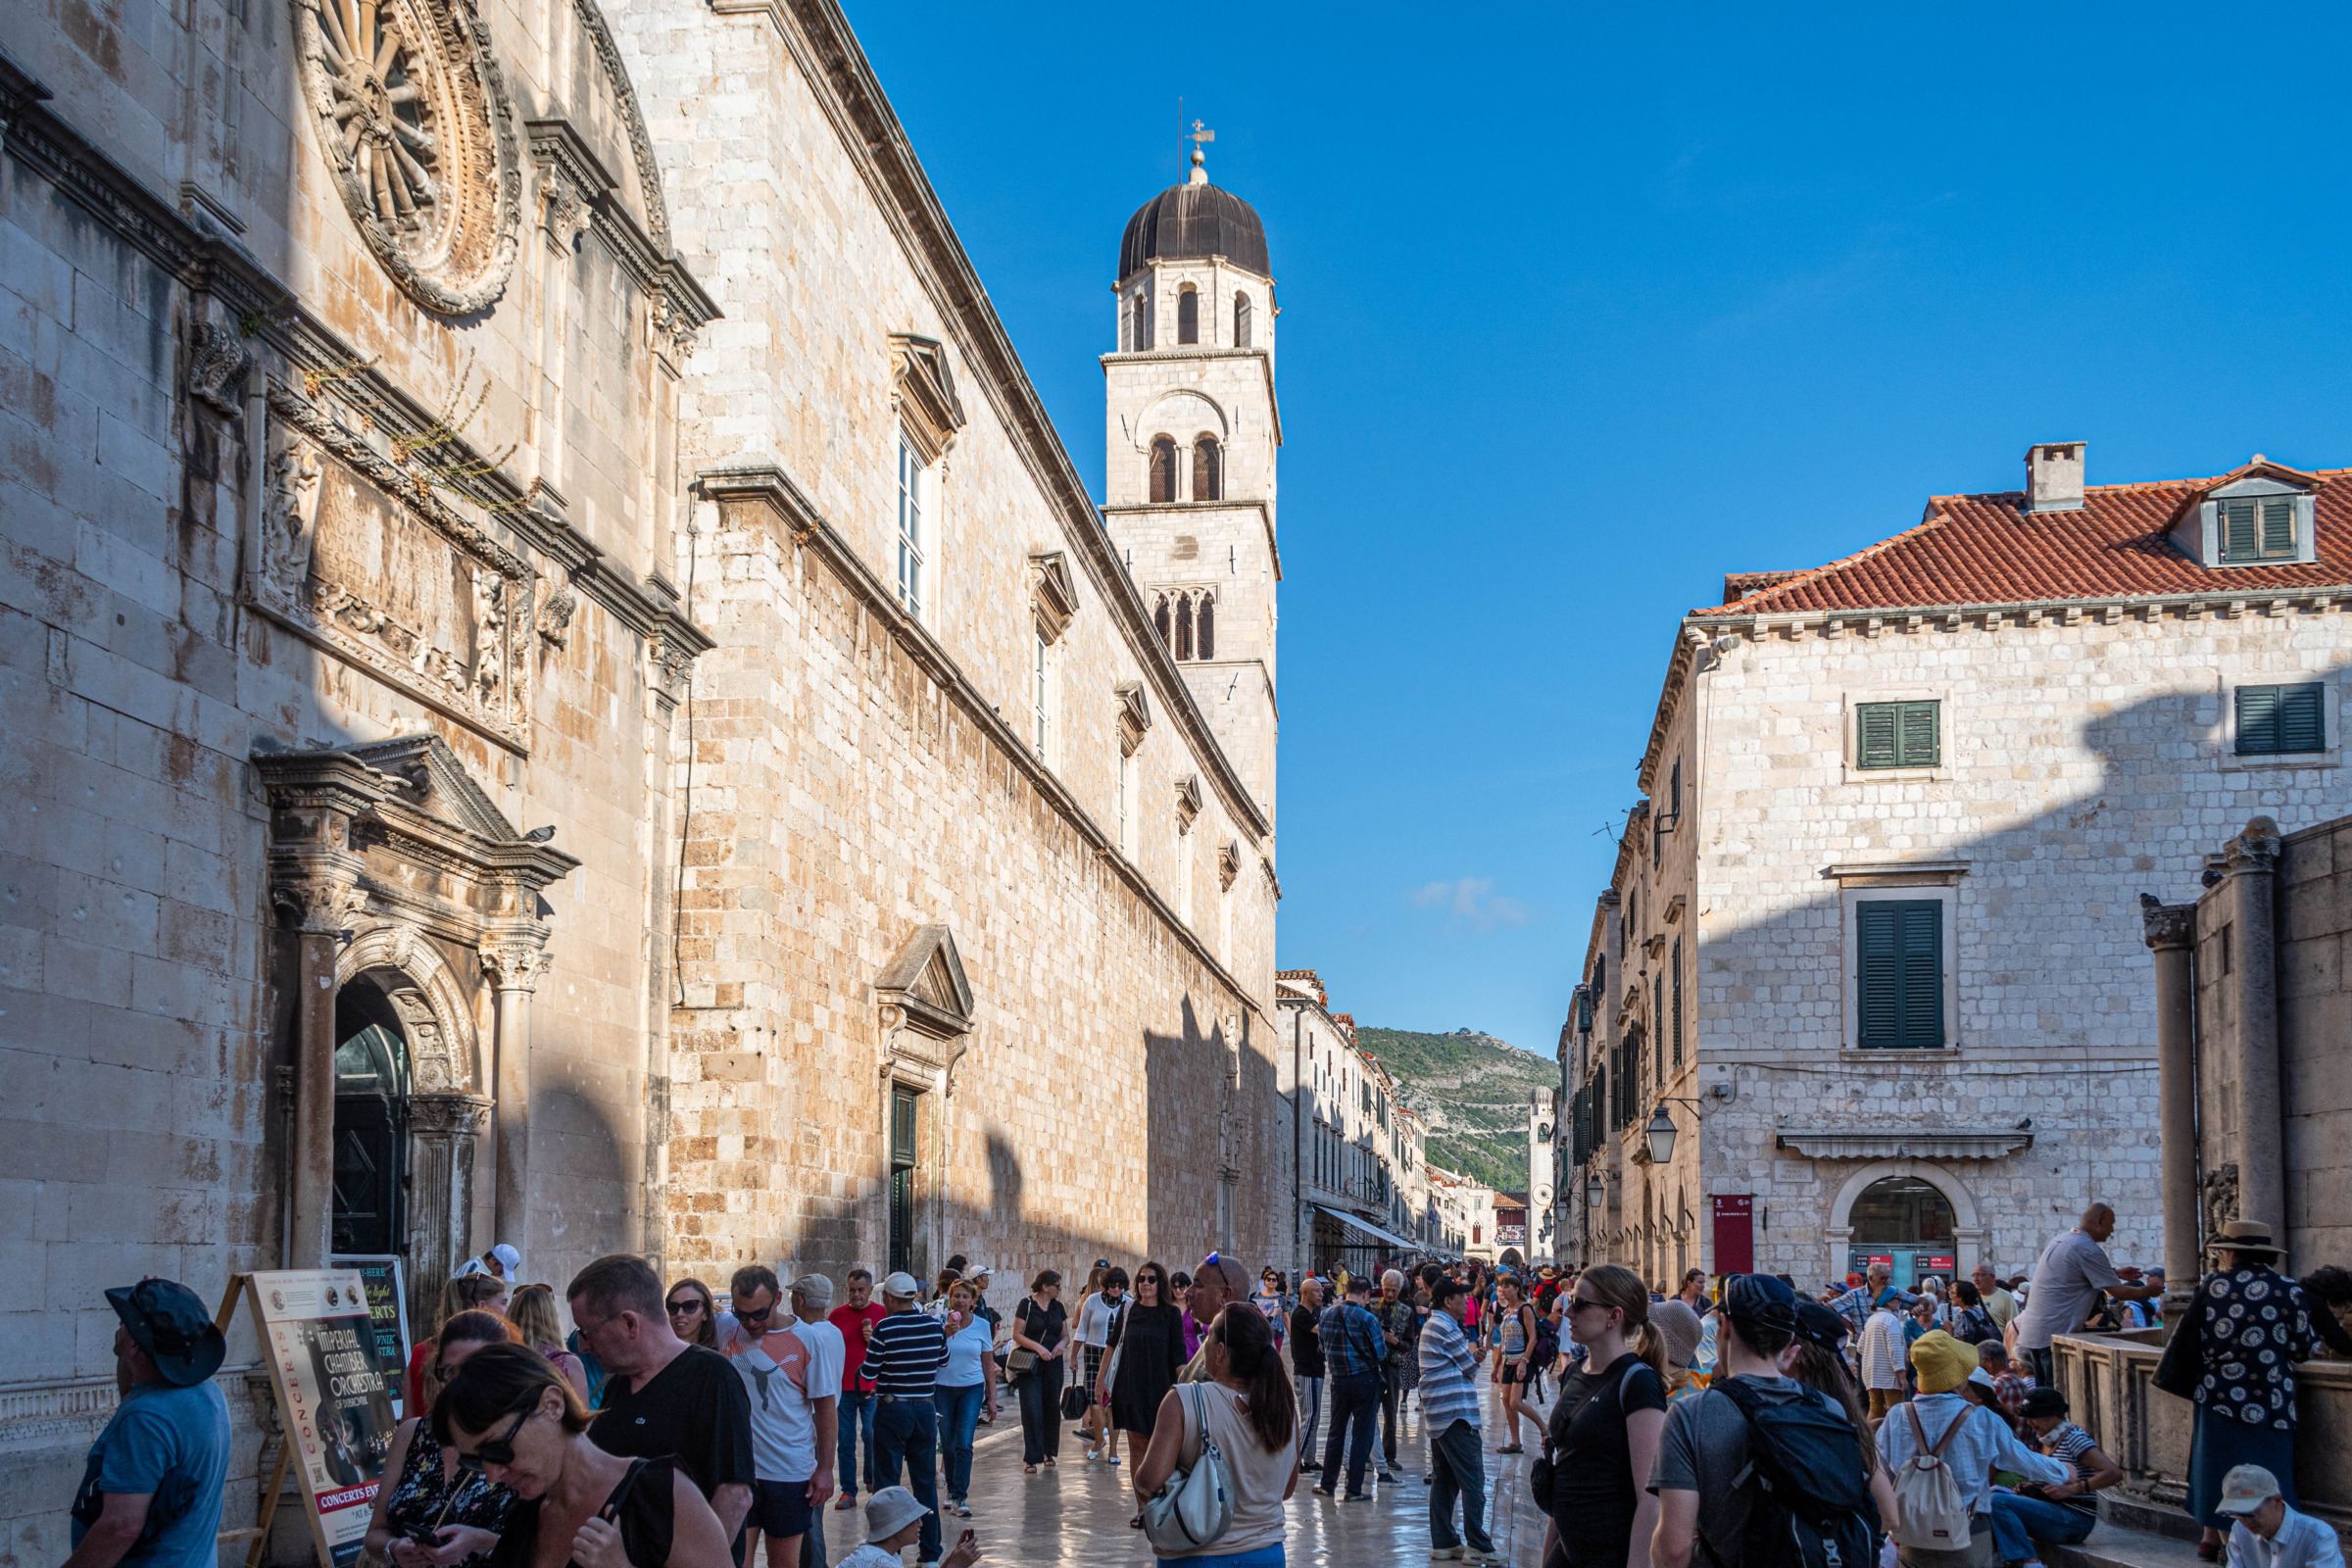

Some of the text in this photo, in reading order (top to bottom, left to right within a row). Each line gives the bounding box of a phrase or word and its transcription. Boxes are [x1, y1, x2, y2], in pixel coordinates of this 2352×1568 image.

[317, 1328, 361, 1352] IMPERIAL
[324, 1351, 368, 1374] CHAMBER
[276, 1331, 316, 1454] CONCERTS
[330, 1371, 384, 1396] ORCHESTRA
[320, 1488, 366, 1508] CONCERTS
